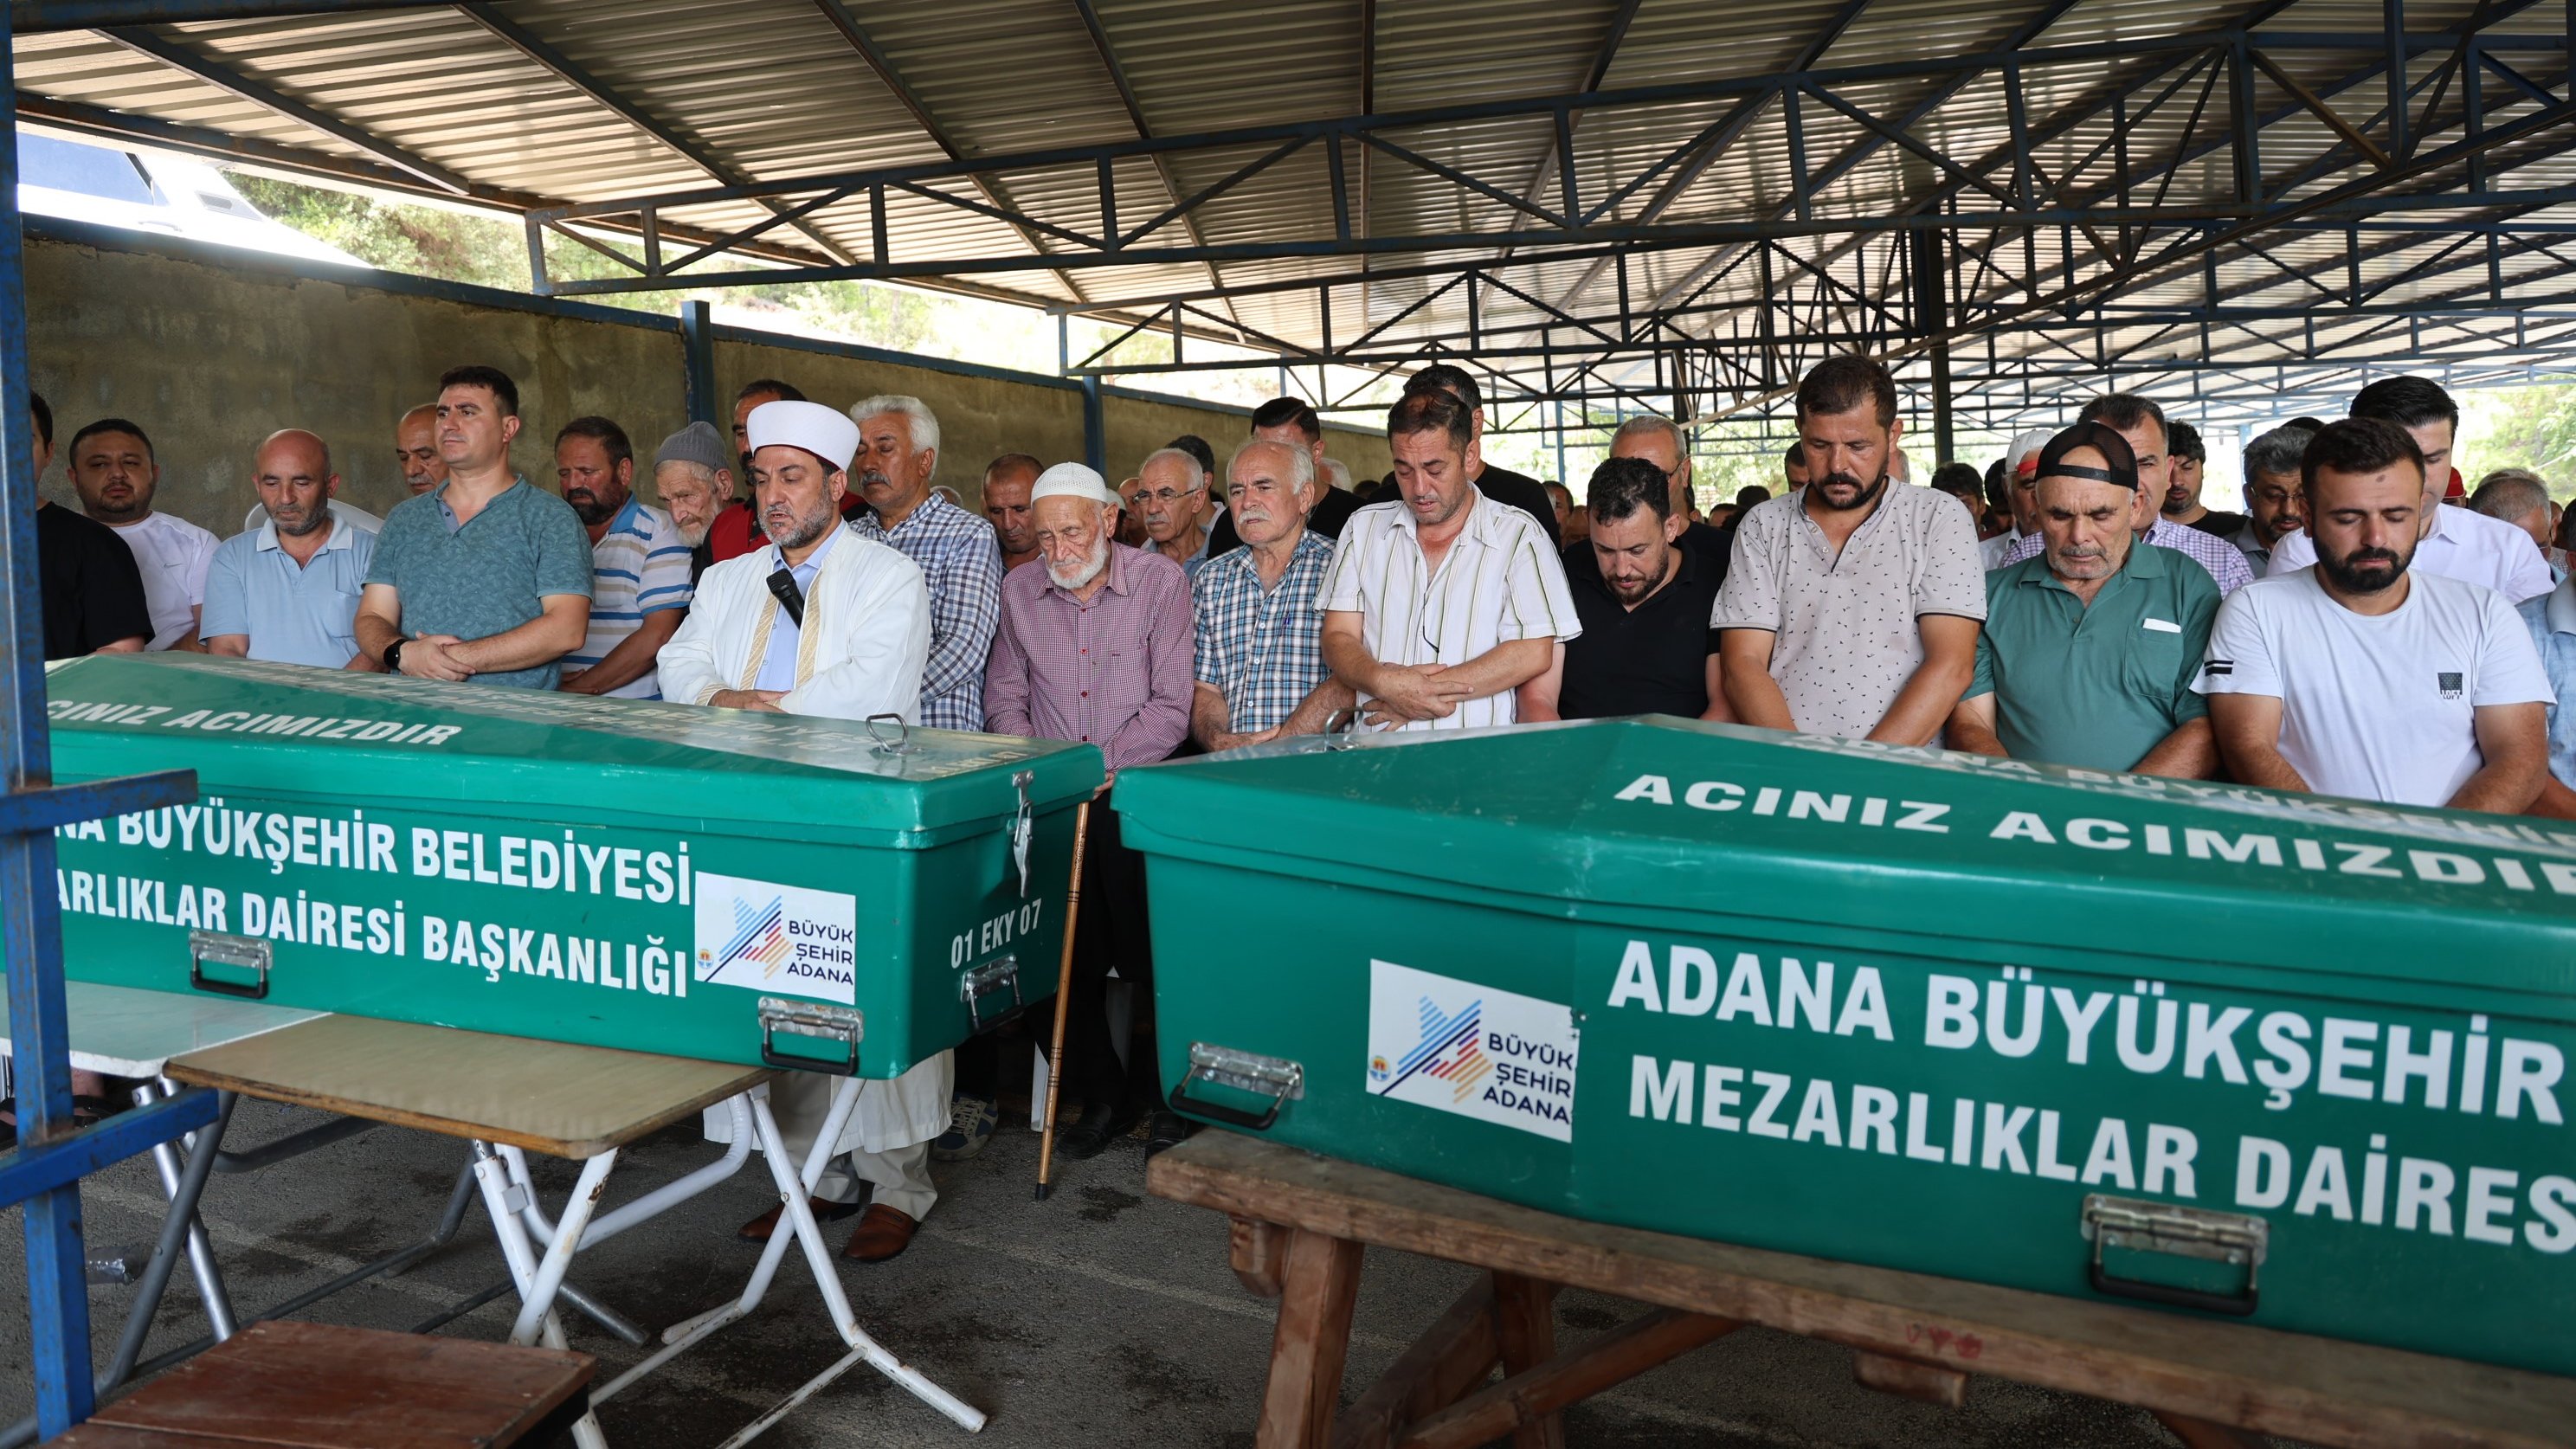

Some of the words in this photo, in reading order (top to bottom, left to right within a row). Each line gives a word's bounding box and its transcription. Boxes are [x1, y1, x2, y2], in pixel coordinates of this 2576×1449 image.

[47, 700, 172, 725] CINIZ
[161, 709, 462, 745] ACIMIZDIR
[1792, 735, 2040, 775] ADANA
[1613, 774, 1952, 834] ACINIZ
[413, 828, 691, 907] BELEDİYESİ
[242, 890, 405, 957] DAİRESİ
[423, 917, 687, 999] BAŞKANLIĞI
[789, 919, 853, 944] BÜYÜK
[950, 928, 974, 969] 01
[981, 910, 1016, 956] EKY
[1020, 898, 1042, 936] 07
[787, 962, 853, 986] ADANA
[795, 943, 853, 966] ŞEHİR
[1488, 1032, 1574, 1072] BÜYÜK
[1607, 940, 1894, 1041] ADANA
[1924, 965, 2565, 1126] BÜYÜKŞEHİR
[1496, 1062, 1571, 1098] ŞEHİR
[1483, 1086, 1570, 1124] ADANA
[1629, 1054, 2198, 1200] MEZARLIKLAR
